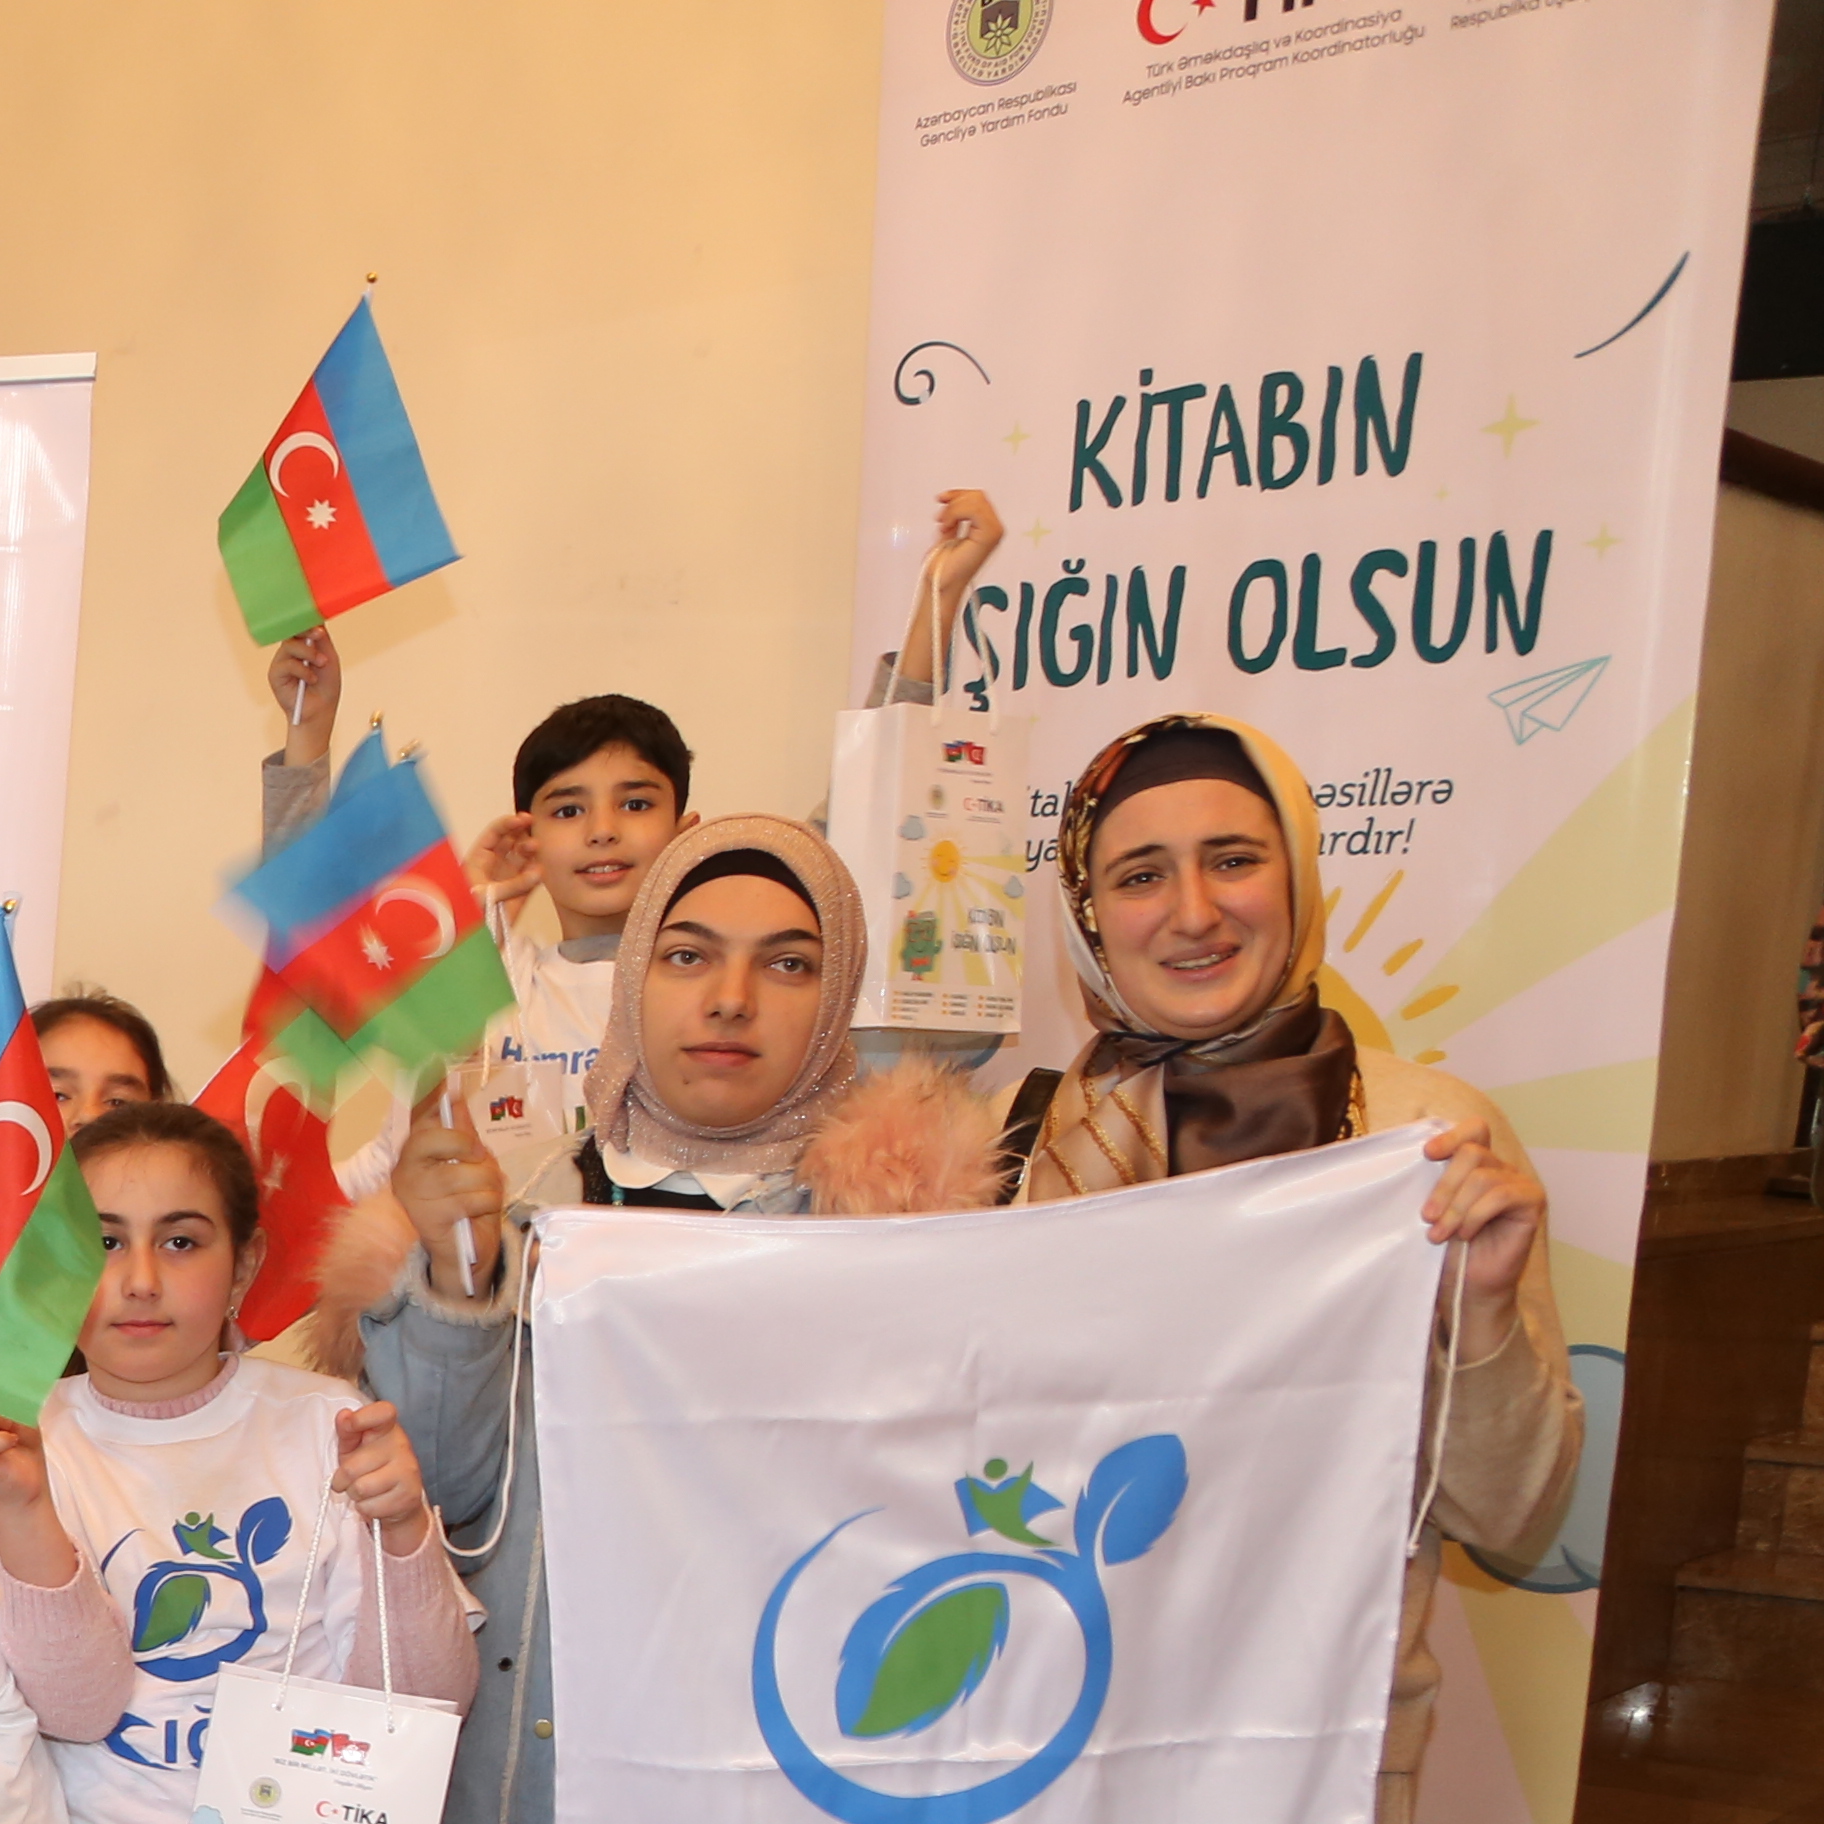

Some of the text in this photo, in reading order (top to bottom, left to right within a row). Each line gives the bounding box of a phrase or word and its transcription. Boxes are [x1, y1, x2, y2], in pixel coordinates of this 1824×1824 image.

[1146, 62, 1175, 79] Türk
[1274, 35, 1291, 50] və
[1294, 8, 1402, 44] Koordinasiya
[1185, 71, 1216, 90] Bakı
[1219, 55, 1289, 81] Proqram
[1291, 23, 1426, 64] Koordinatorluğu
[914, 80, 1078, 130] Azərbaycan Respublikası
[920, 101, 1069, 148] Gəncliyə Yardım Fondu
[1068, 350, 1423, 514] KİTABIN
[944, 528, 1553, 713] ŞIĞIN OLSUN
[1312, 767, 1455, 811] əsillərə
